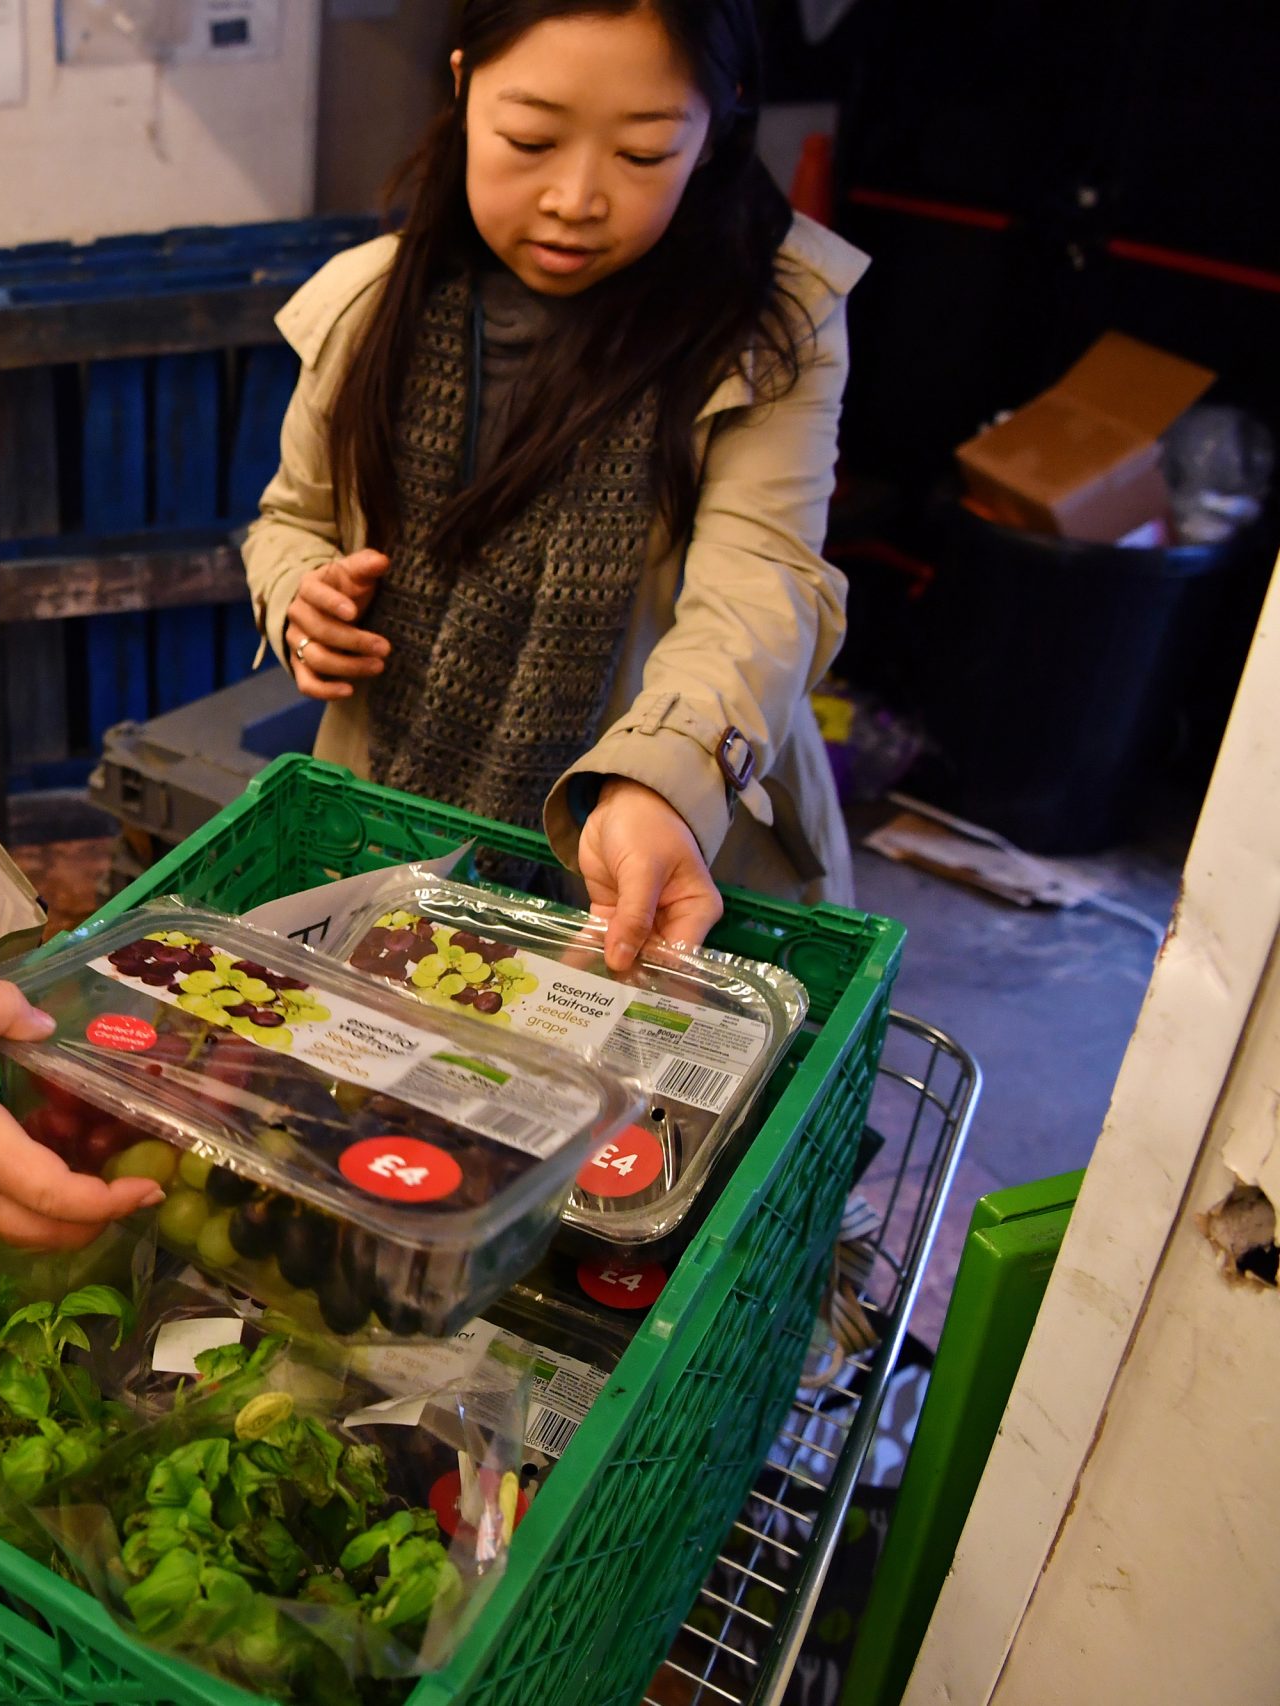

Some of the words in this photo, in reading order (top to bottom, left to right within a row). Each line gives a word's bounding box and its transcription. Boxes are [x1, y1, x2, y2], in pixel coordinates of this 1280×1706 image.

[552, 981, 615, 1007] essential
[525, 1015, 568, 1035] grape
[535, 1004, 591, 1028] seedless
[367, 1154, 429, 1186] £4
[591, 1143, 638, 1176] £4
[598, 1269, 643, 1292] £4
